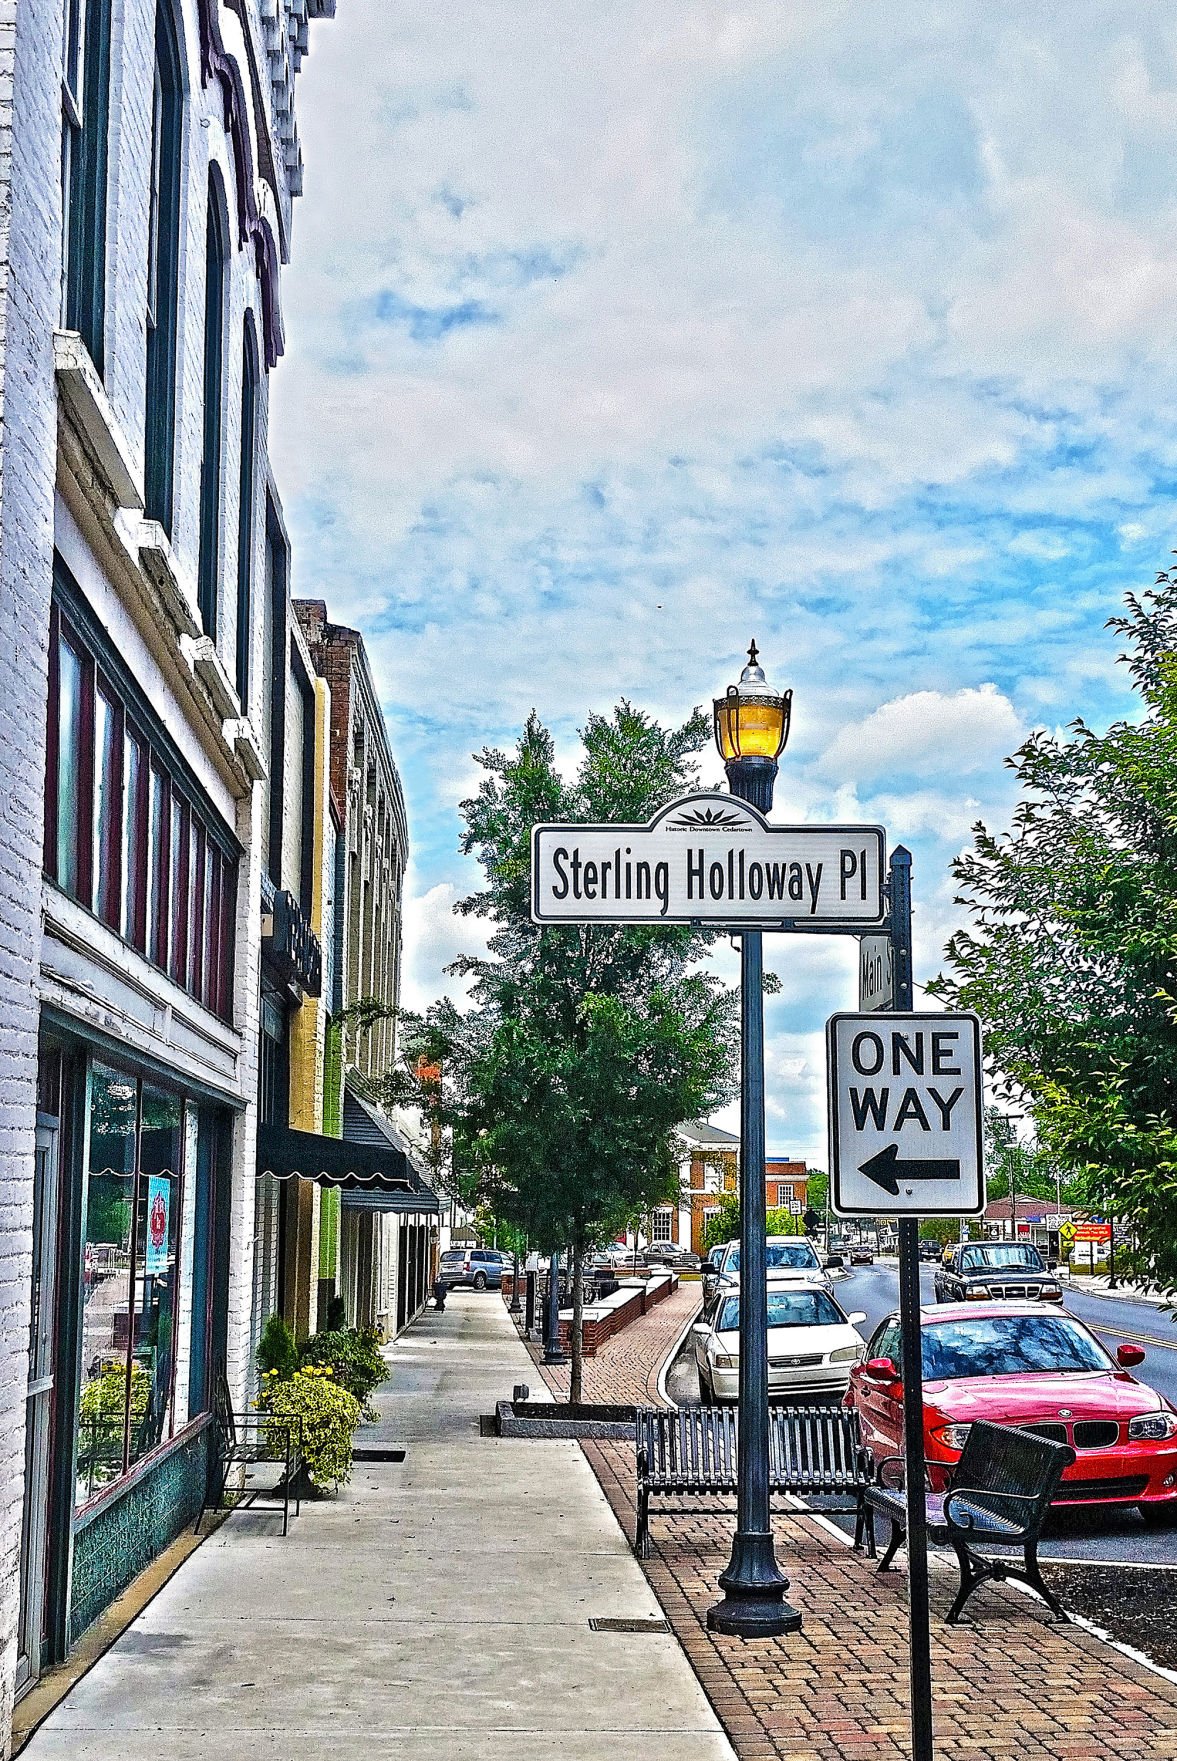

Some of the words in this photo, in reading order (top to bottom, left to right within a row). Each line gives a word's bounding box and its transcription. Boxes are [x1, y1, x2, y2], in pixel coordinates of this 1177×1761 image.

[552, 847, 668, 916] Sterling
[687, 848, 823, 914] Holloway
[840, 848, 867, 900] Pl
[862, 945, 882, 1000] Main
[852, 1031, 961, 1076] ONE
[848, 1087, 965, 1131] WAY
